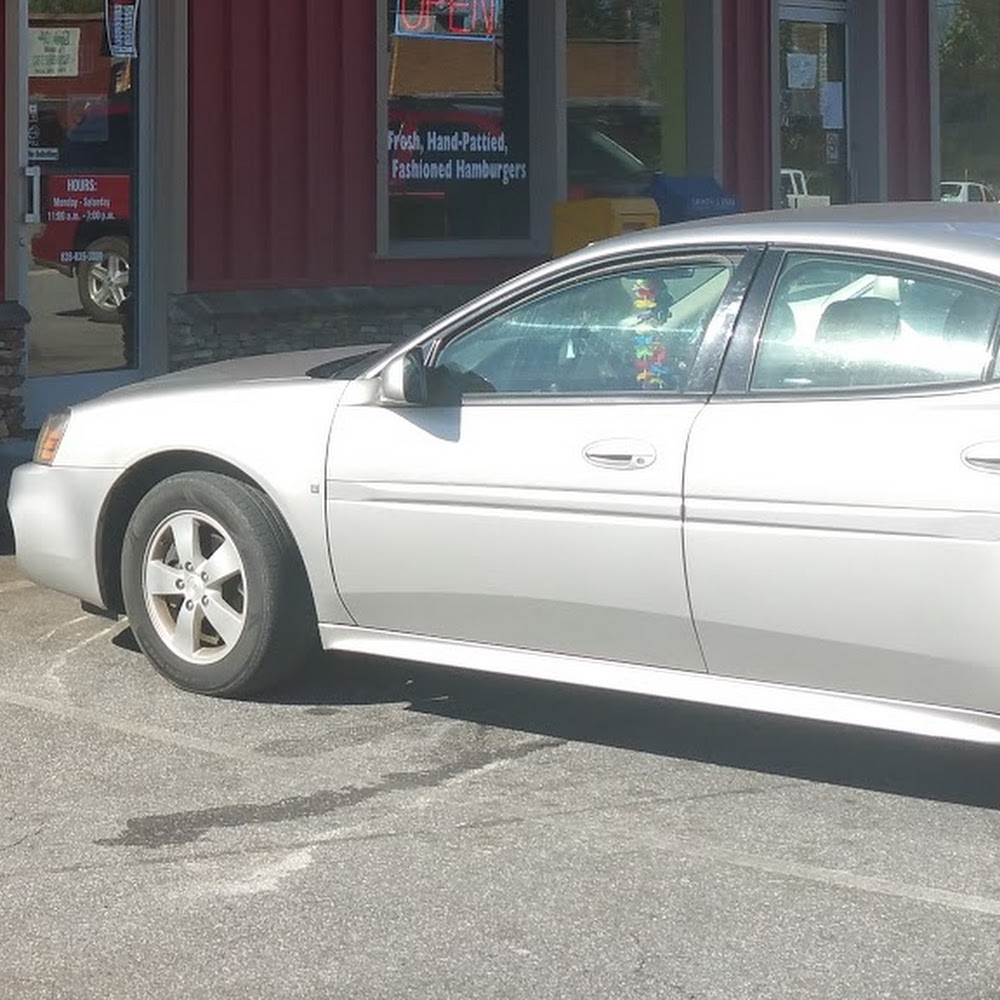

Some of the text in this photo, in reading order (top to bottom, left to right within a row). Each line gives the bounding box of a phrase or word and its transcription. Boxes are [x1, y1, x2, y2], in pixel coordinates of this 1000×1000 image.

[427, 131, 508, 155] Hand-Pattied,
[392, 158, 527, 185] Fashioned Hamburgers
[67, 178, 98, 192] HOURS:
[53, 196, 78, 209] Monday
[83, 197, 111, 209] Saturday
